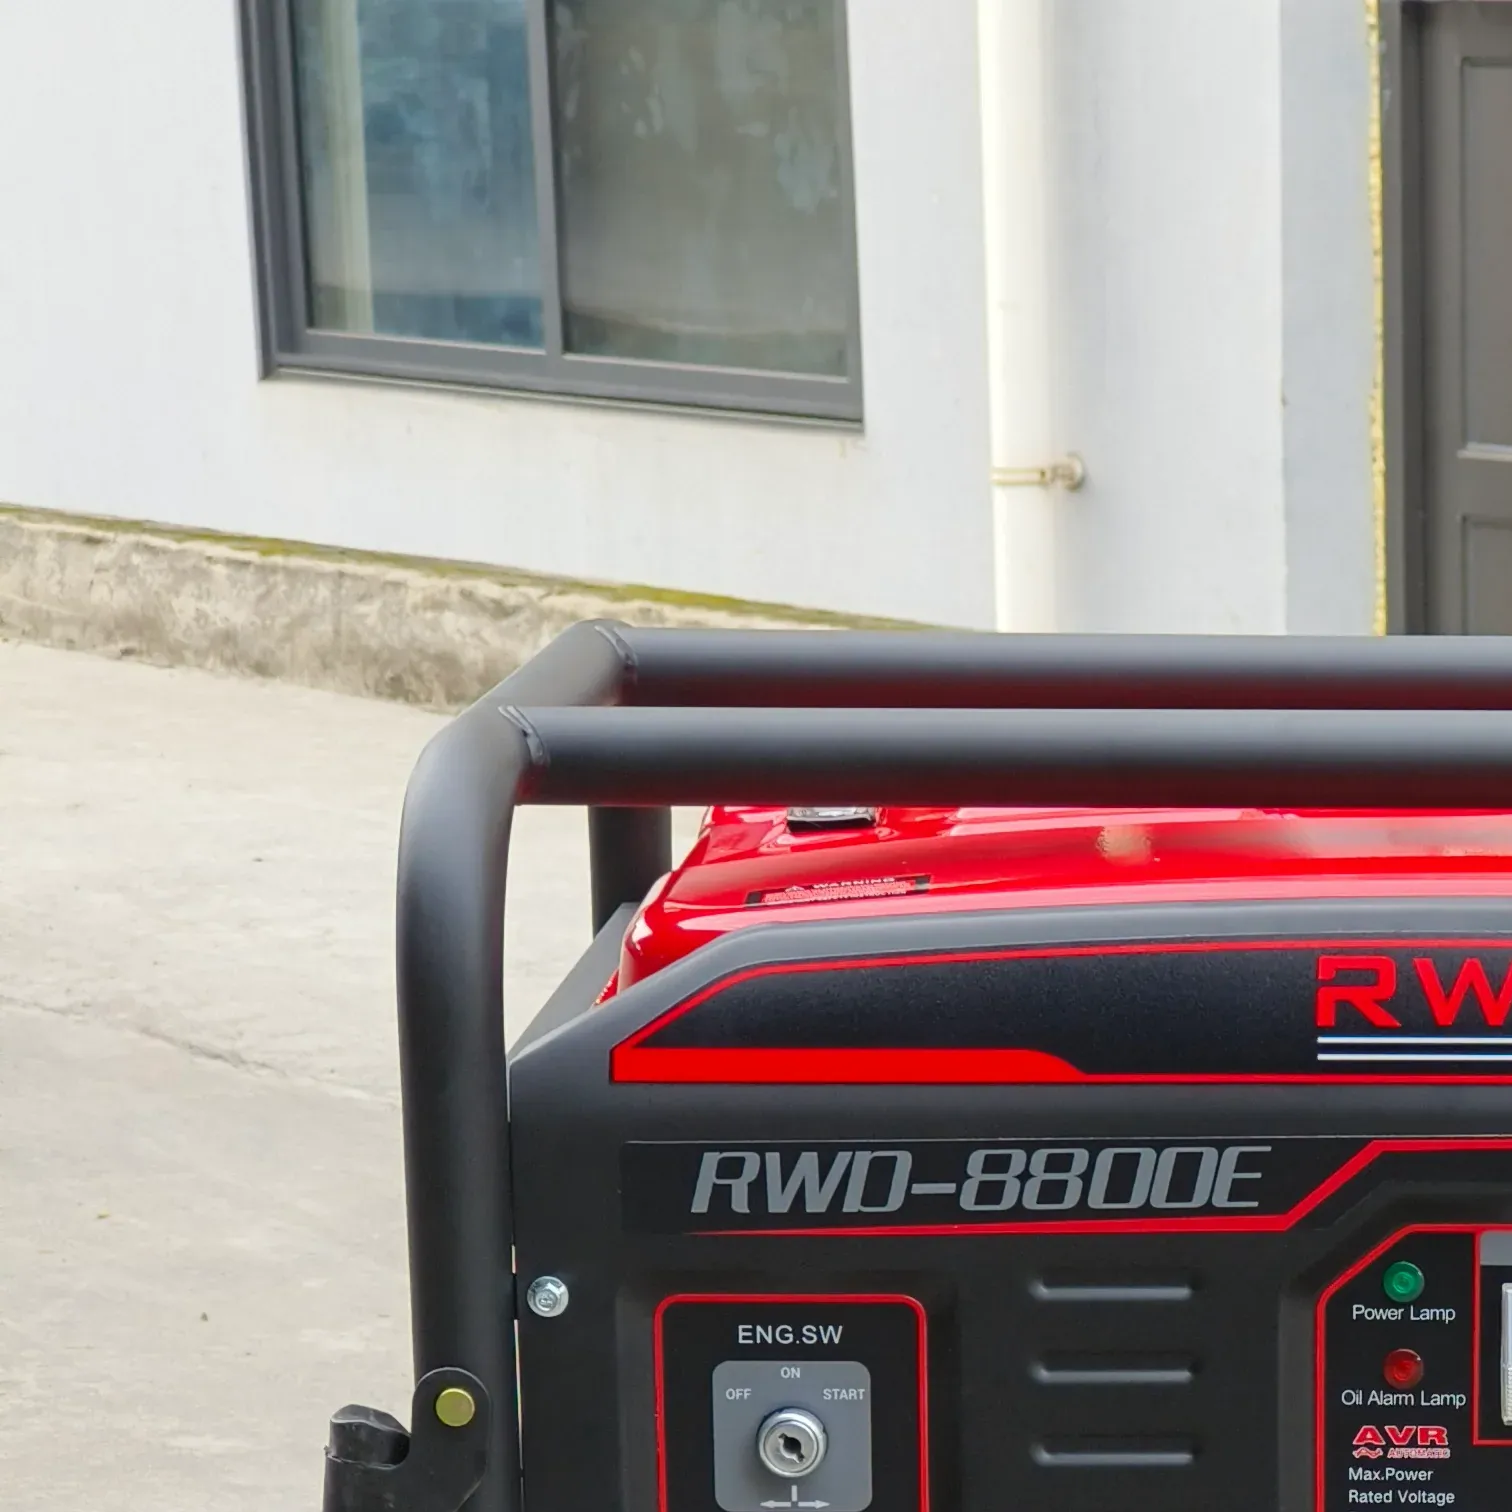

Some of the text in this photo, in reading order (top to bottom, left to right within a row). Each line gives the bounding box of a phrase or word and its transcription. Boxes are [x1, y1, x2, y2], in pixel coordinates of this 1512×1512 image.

[690, 1144, 1272, 1214] RWD-8800E
[1352, 1304, 1456, 1324] Power Lamp
[738, 1325, 843, 1344] ENG.SW
[780, 1367, 801, 1379] ON
[725, 1388, 751, 1400] OFF
[822, 1388, 865, 1400] START
[1341, 1390, 1466, 1409] Oil Alarm Lamp
[1352, 1425, 1449, 1445] AVR
[1349, 1467, 1433, 1481] Max.Power
[1349, 1490, 1455, 1506] Rated Voltage
